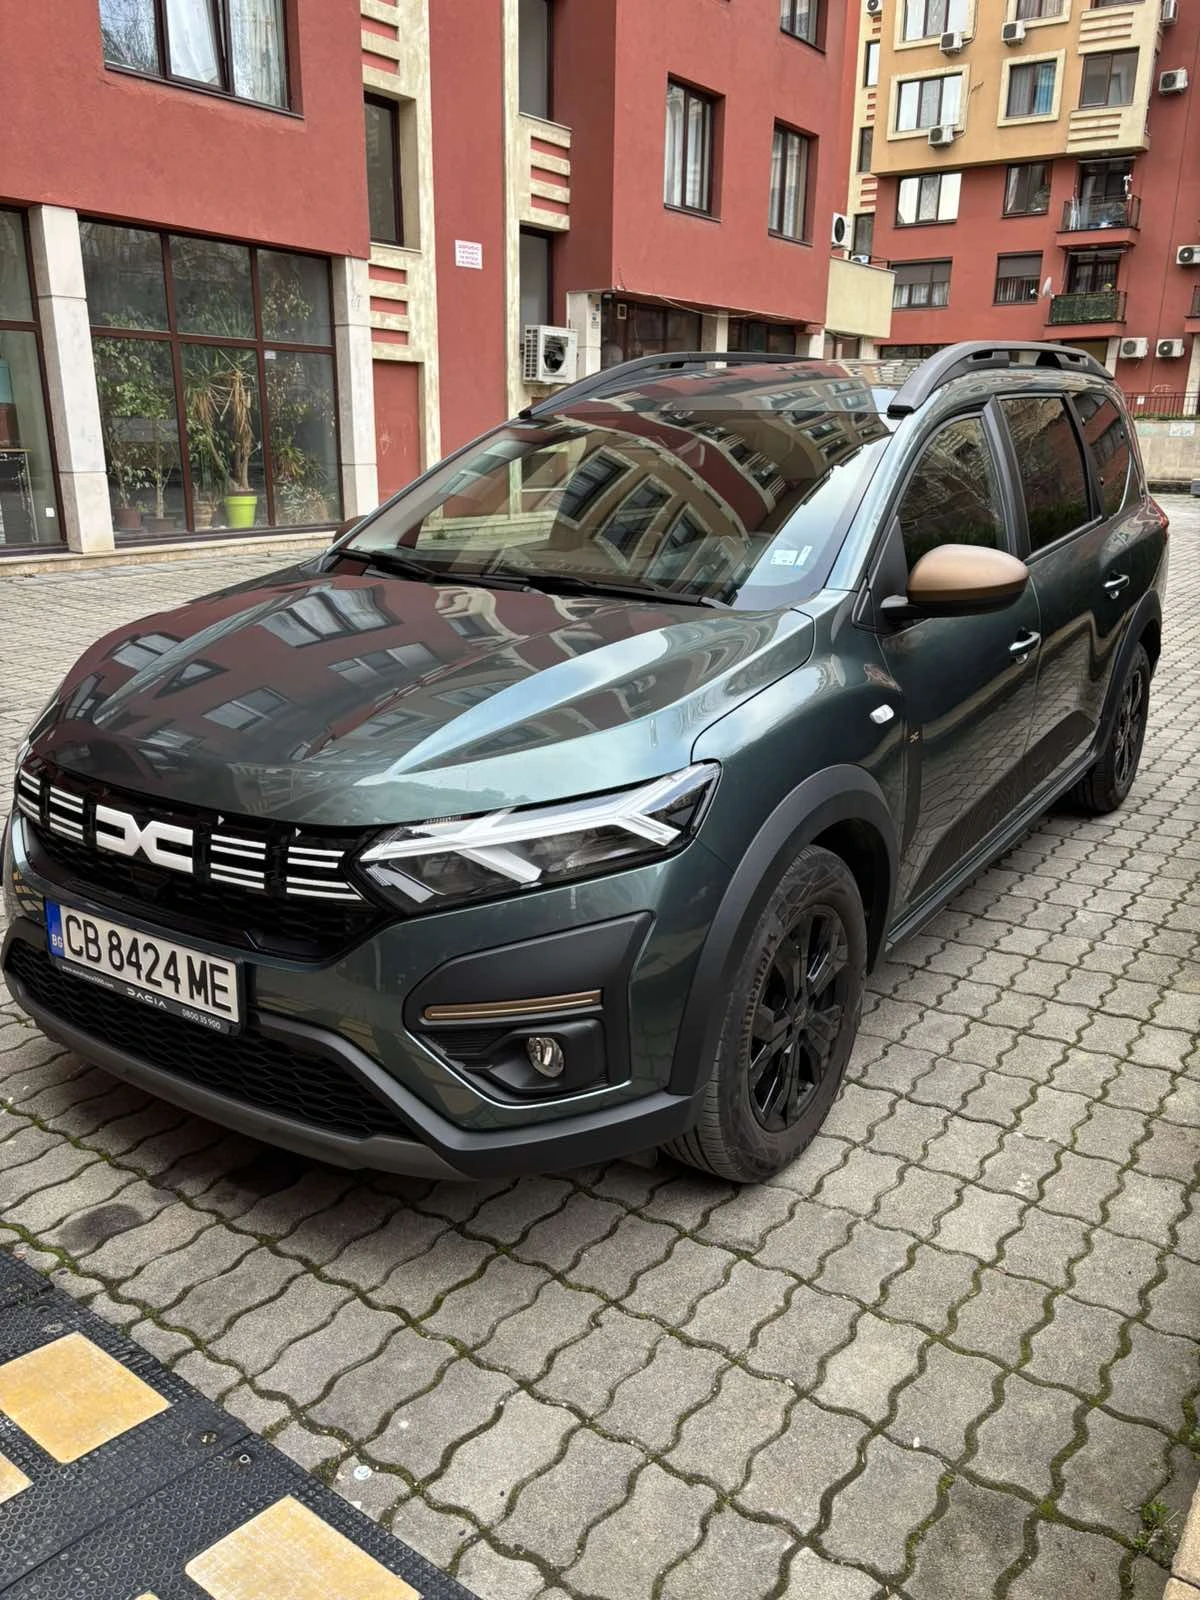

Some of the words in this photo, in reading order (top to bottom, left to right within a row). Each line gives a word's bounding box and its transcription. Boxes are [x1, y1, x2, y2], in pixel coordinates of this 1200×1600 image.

[51, 933, 64, 948] BG
[65, 914, 102, 963] CB
[107, 929, 181, 994] 8424
[186, 954, 232, 1013] ME
[126, 987, 168, 1008] DACIA
